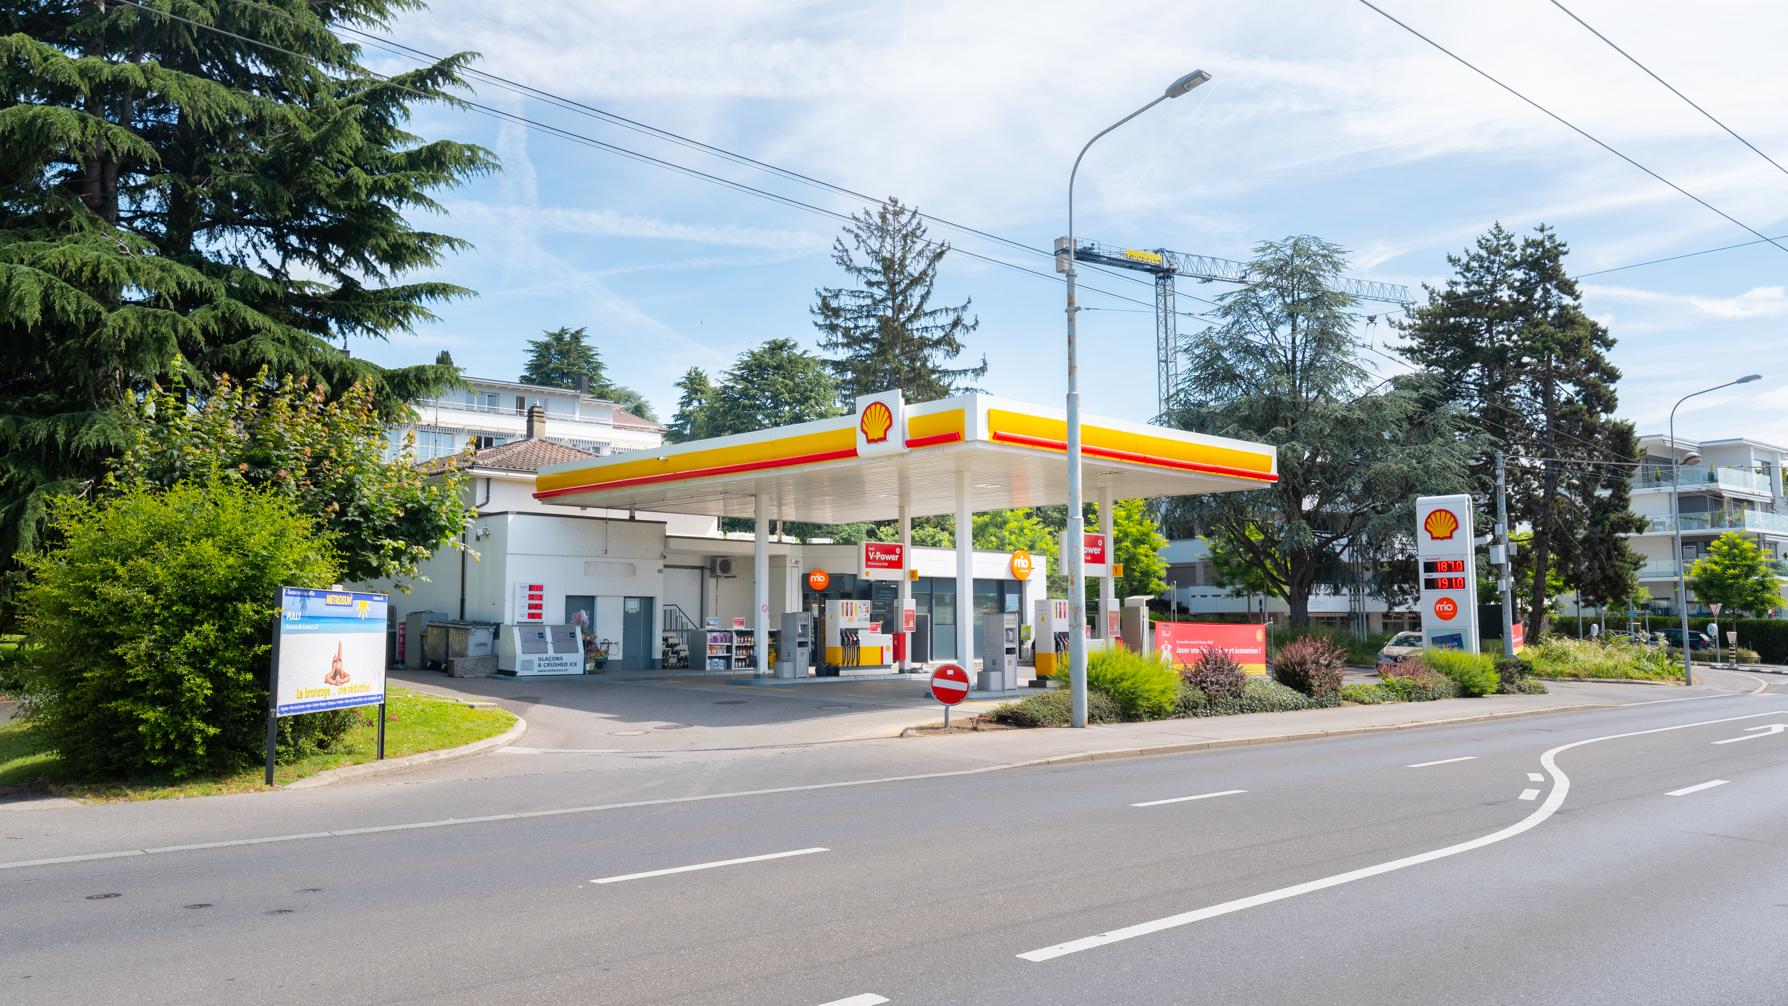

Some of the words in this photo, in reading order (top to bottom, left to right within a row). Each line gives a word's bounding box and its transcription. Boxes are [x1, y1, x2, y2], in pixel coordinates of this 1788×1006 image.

[1084, 546, 1102, 555] ower
[868, 552, 900, 561] V-Power
[1014, 555, 1029, 568] mio
[1437, 561, 1463, 572] 187.0
[810, 573, 825, 582] mio
[1438, 577, 1464, 589] 191.0
[1436, 601, 1454, 612] mio
